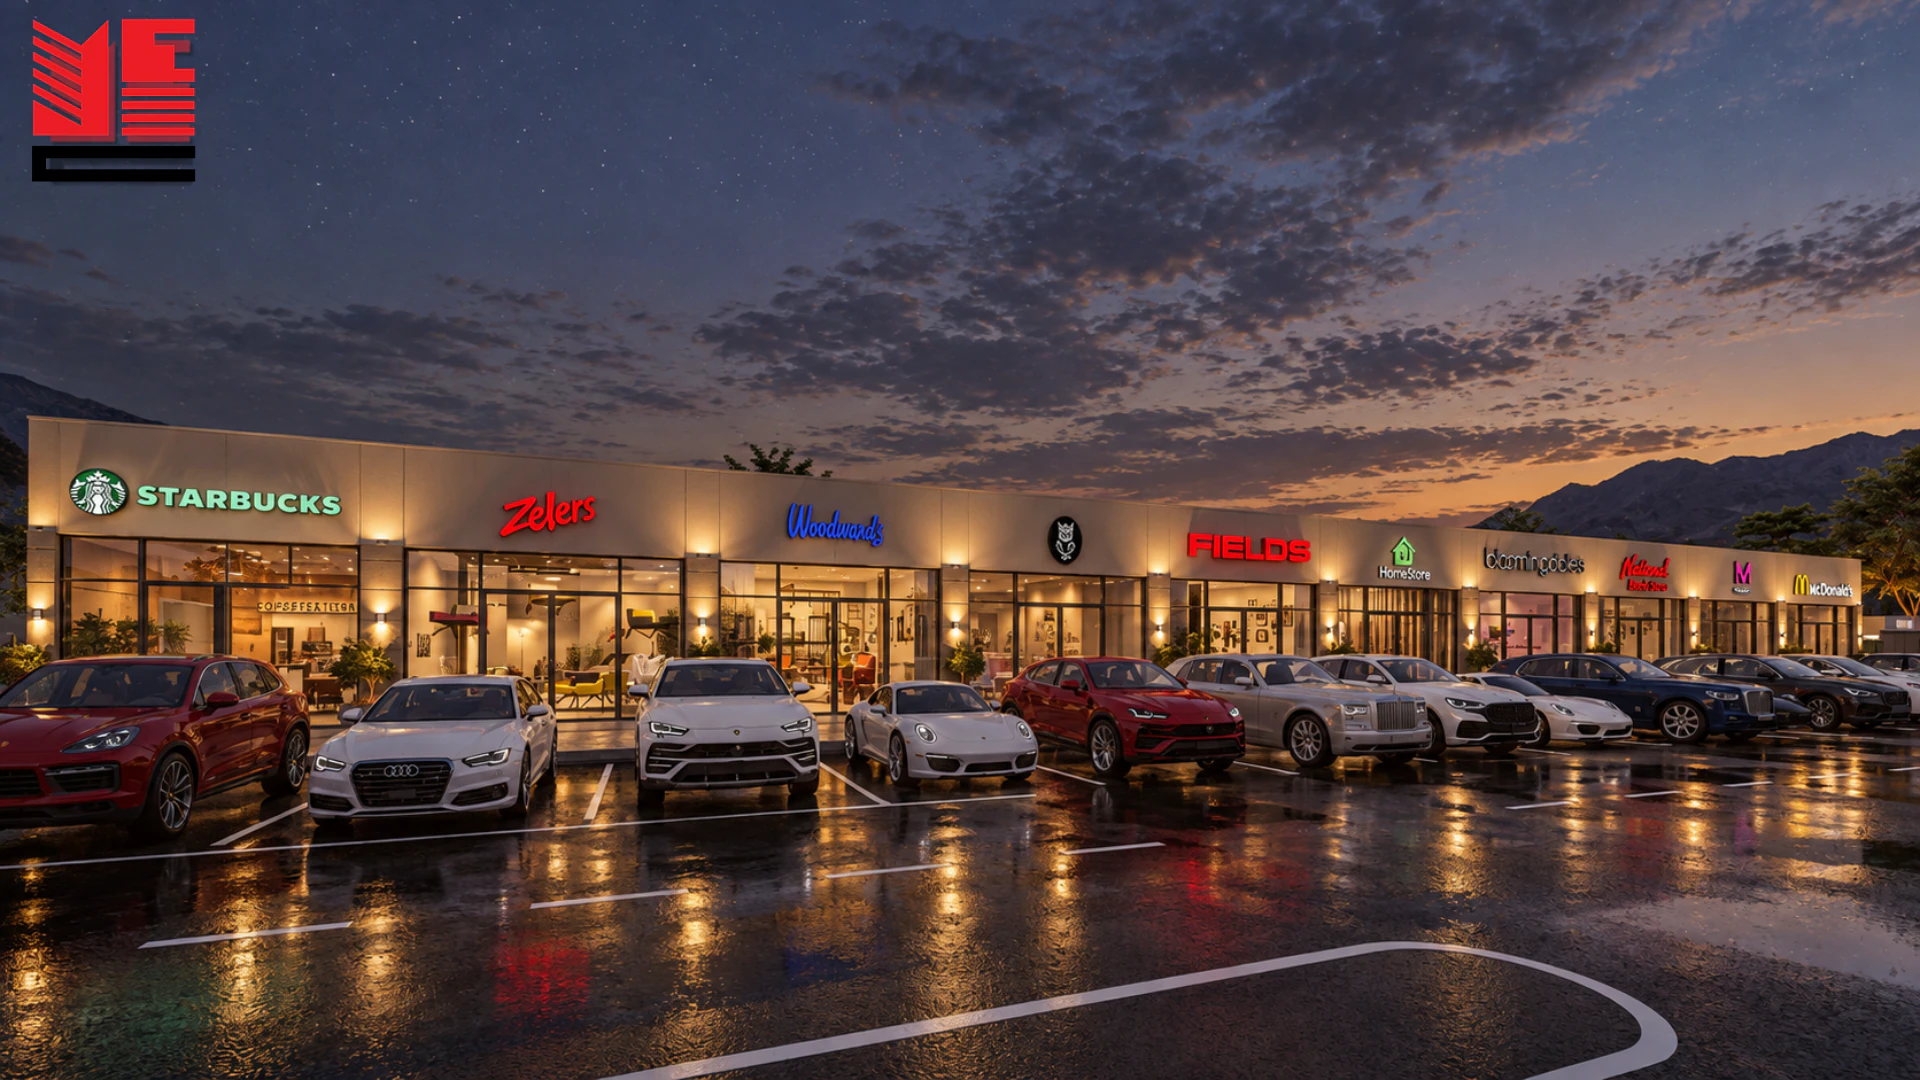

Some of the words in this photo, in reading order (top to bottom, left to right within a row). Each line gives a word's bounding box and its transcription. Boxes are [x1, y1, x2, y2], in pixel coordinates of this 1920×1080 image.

[137, 485, 342, 516] STARBUCKS
[500, 491, 596, 537] Zelers
[1187, 532, 1311, 563] FIELDS
